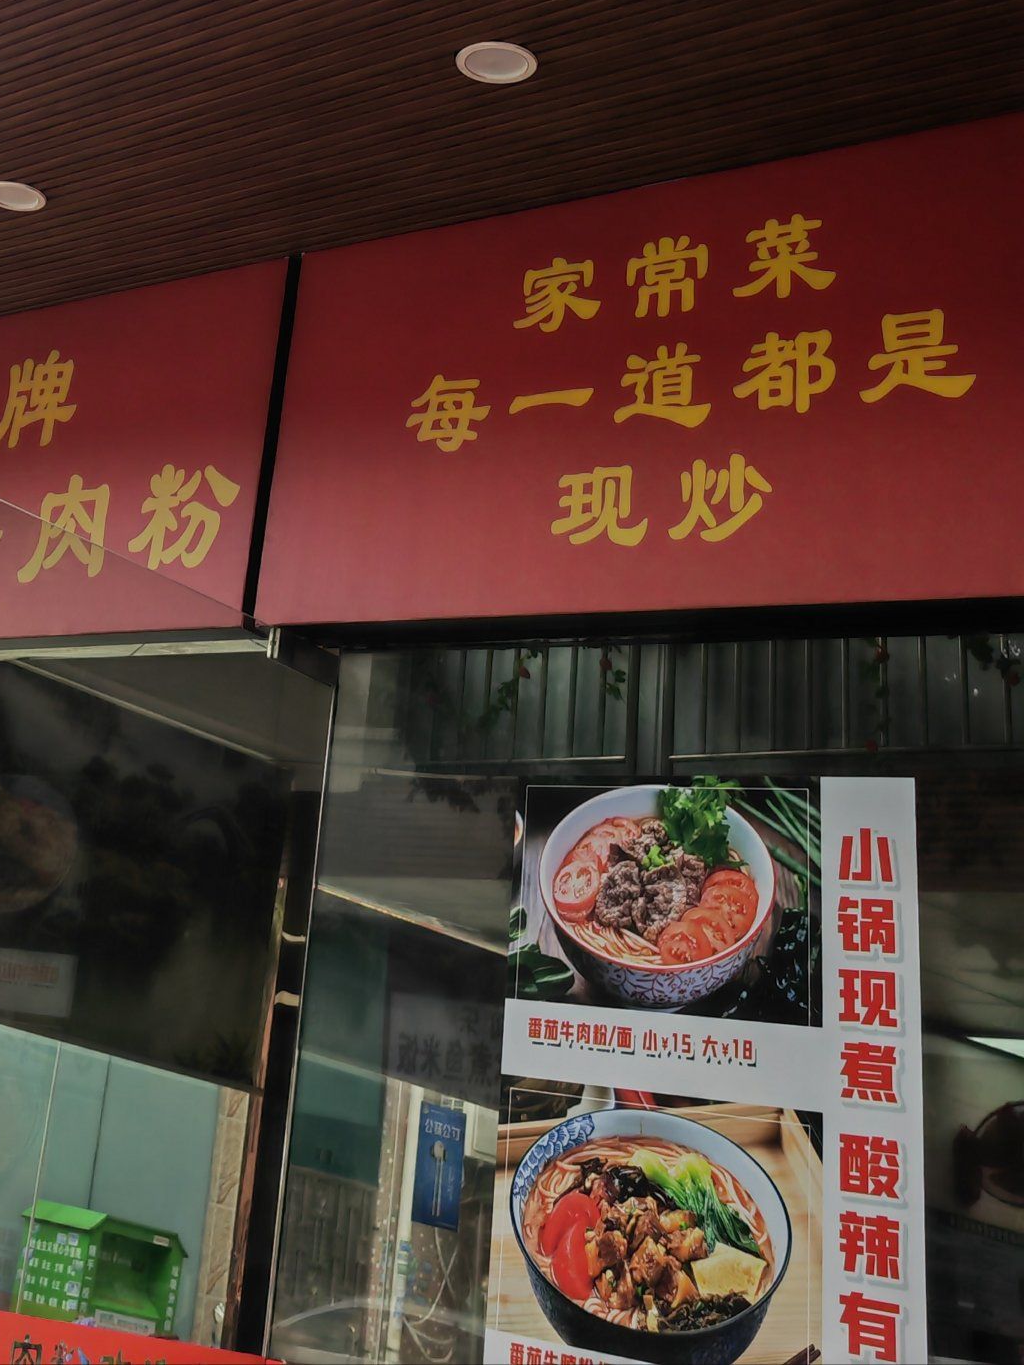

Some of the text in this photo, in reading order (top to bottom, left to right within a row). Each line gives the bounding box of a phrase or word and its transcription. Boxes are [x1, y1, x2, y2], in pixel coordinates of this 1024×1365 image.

[513, 213, 836, 333] 家常菜
[405, 309, 977, 453] 每一道都是
[551, 454, 773, 547] 现炒
[528, 1017, 633, 1050] 番茄牛肉粉/面
[837, 827, 902, 1364] 小锅现煮 酸辣有
